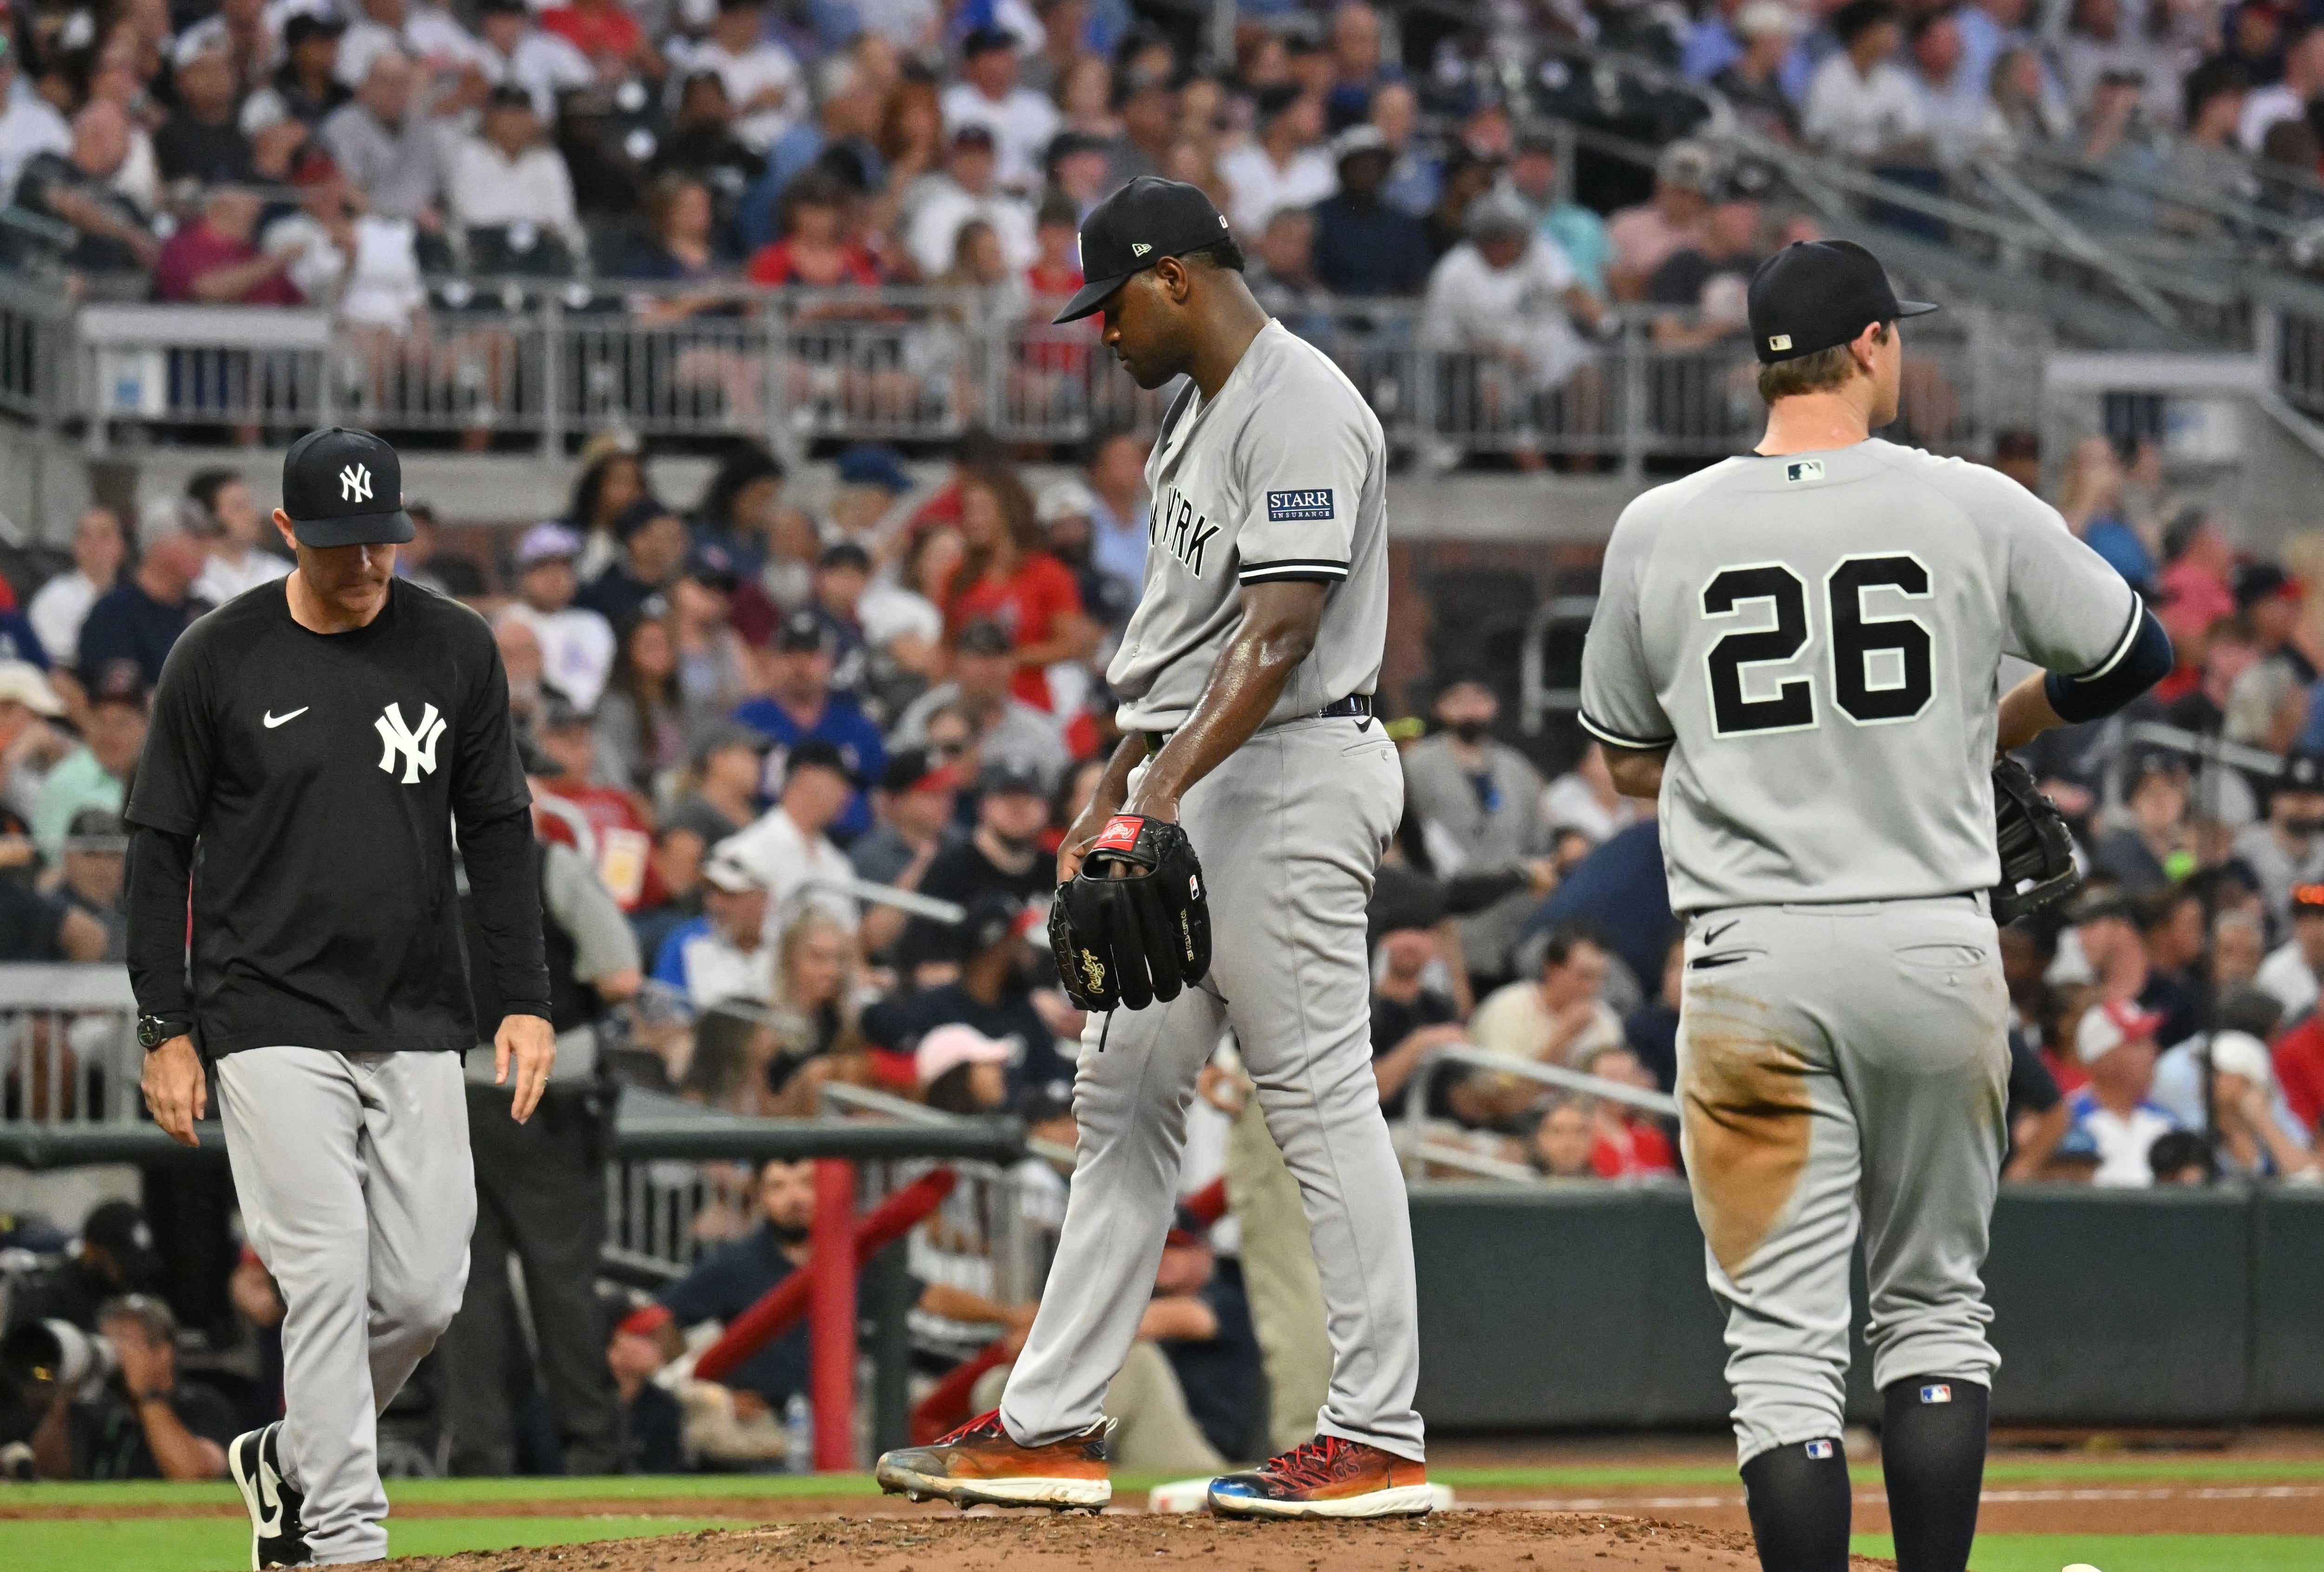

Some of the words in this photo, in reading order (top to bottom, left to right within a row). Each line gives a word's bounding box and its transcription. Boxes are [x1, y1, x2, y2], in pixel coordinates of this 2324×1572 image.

[339, 462, 373, 503] NY
[1271, 491, 1330, 508] STARR
[1698, 550, 1938, 740] 26
[374, 702, 447, 784] NY
[1081, 948, 1104, 994] Rawlings
